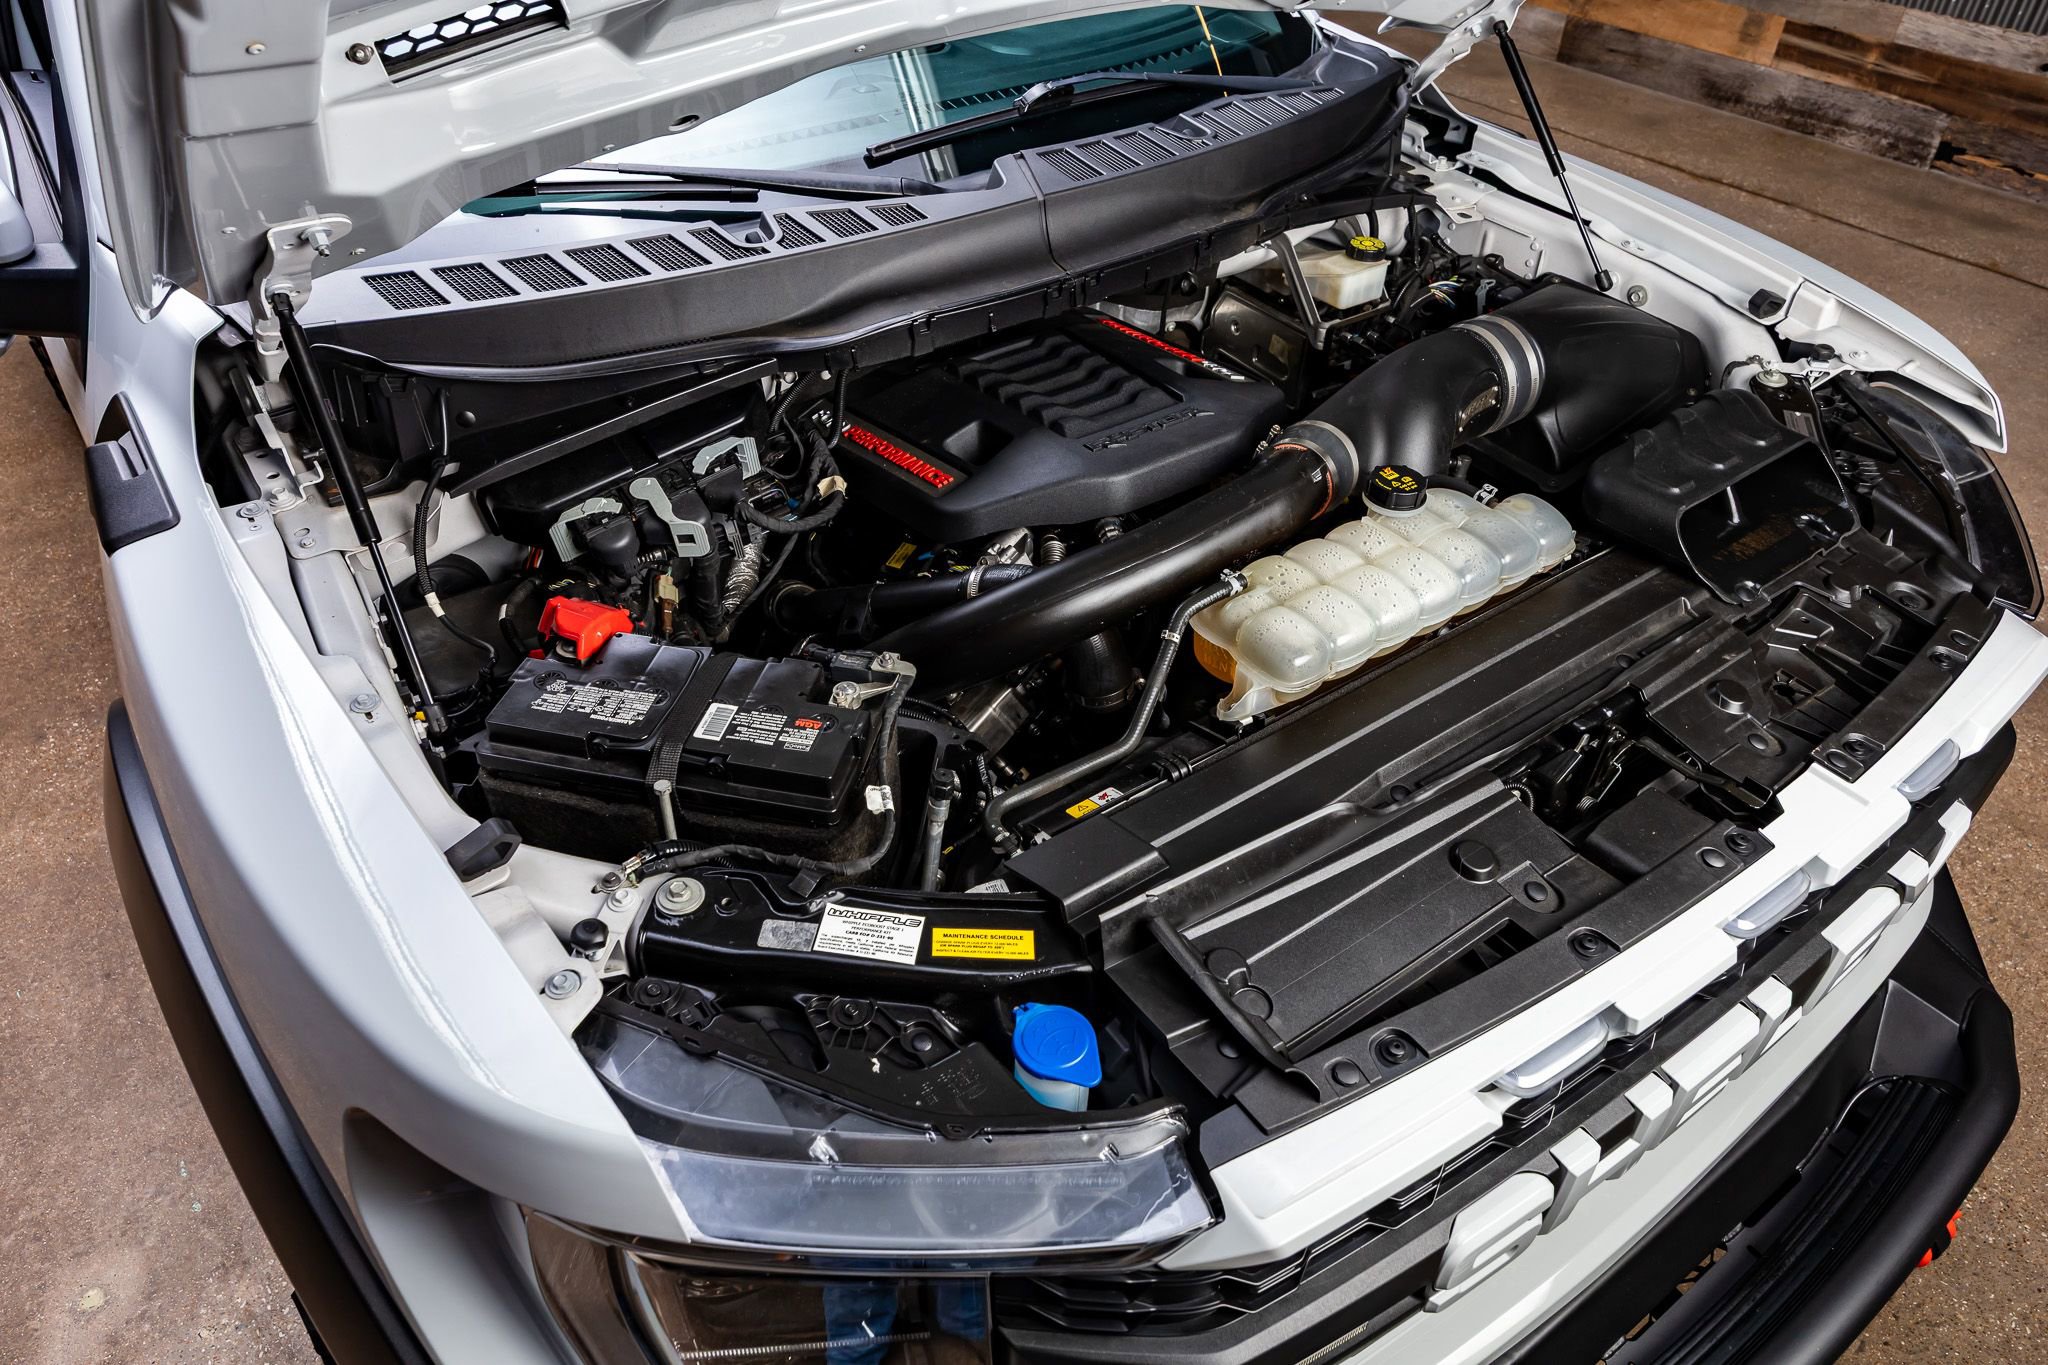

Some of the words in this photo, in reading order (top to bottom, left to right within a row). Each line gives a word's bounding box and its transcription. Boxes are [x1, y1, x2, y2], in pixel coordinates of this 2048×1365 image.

[841, 425, 954, 489] PERFORMANCE
[795, 720, 822, 729] AGM
[828, 908, 922, 927] WHIPPLE
